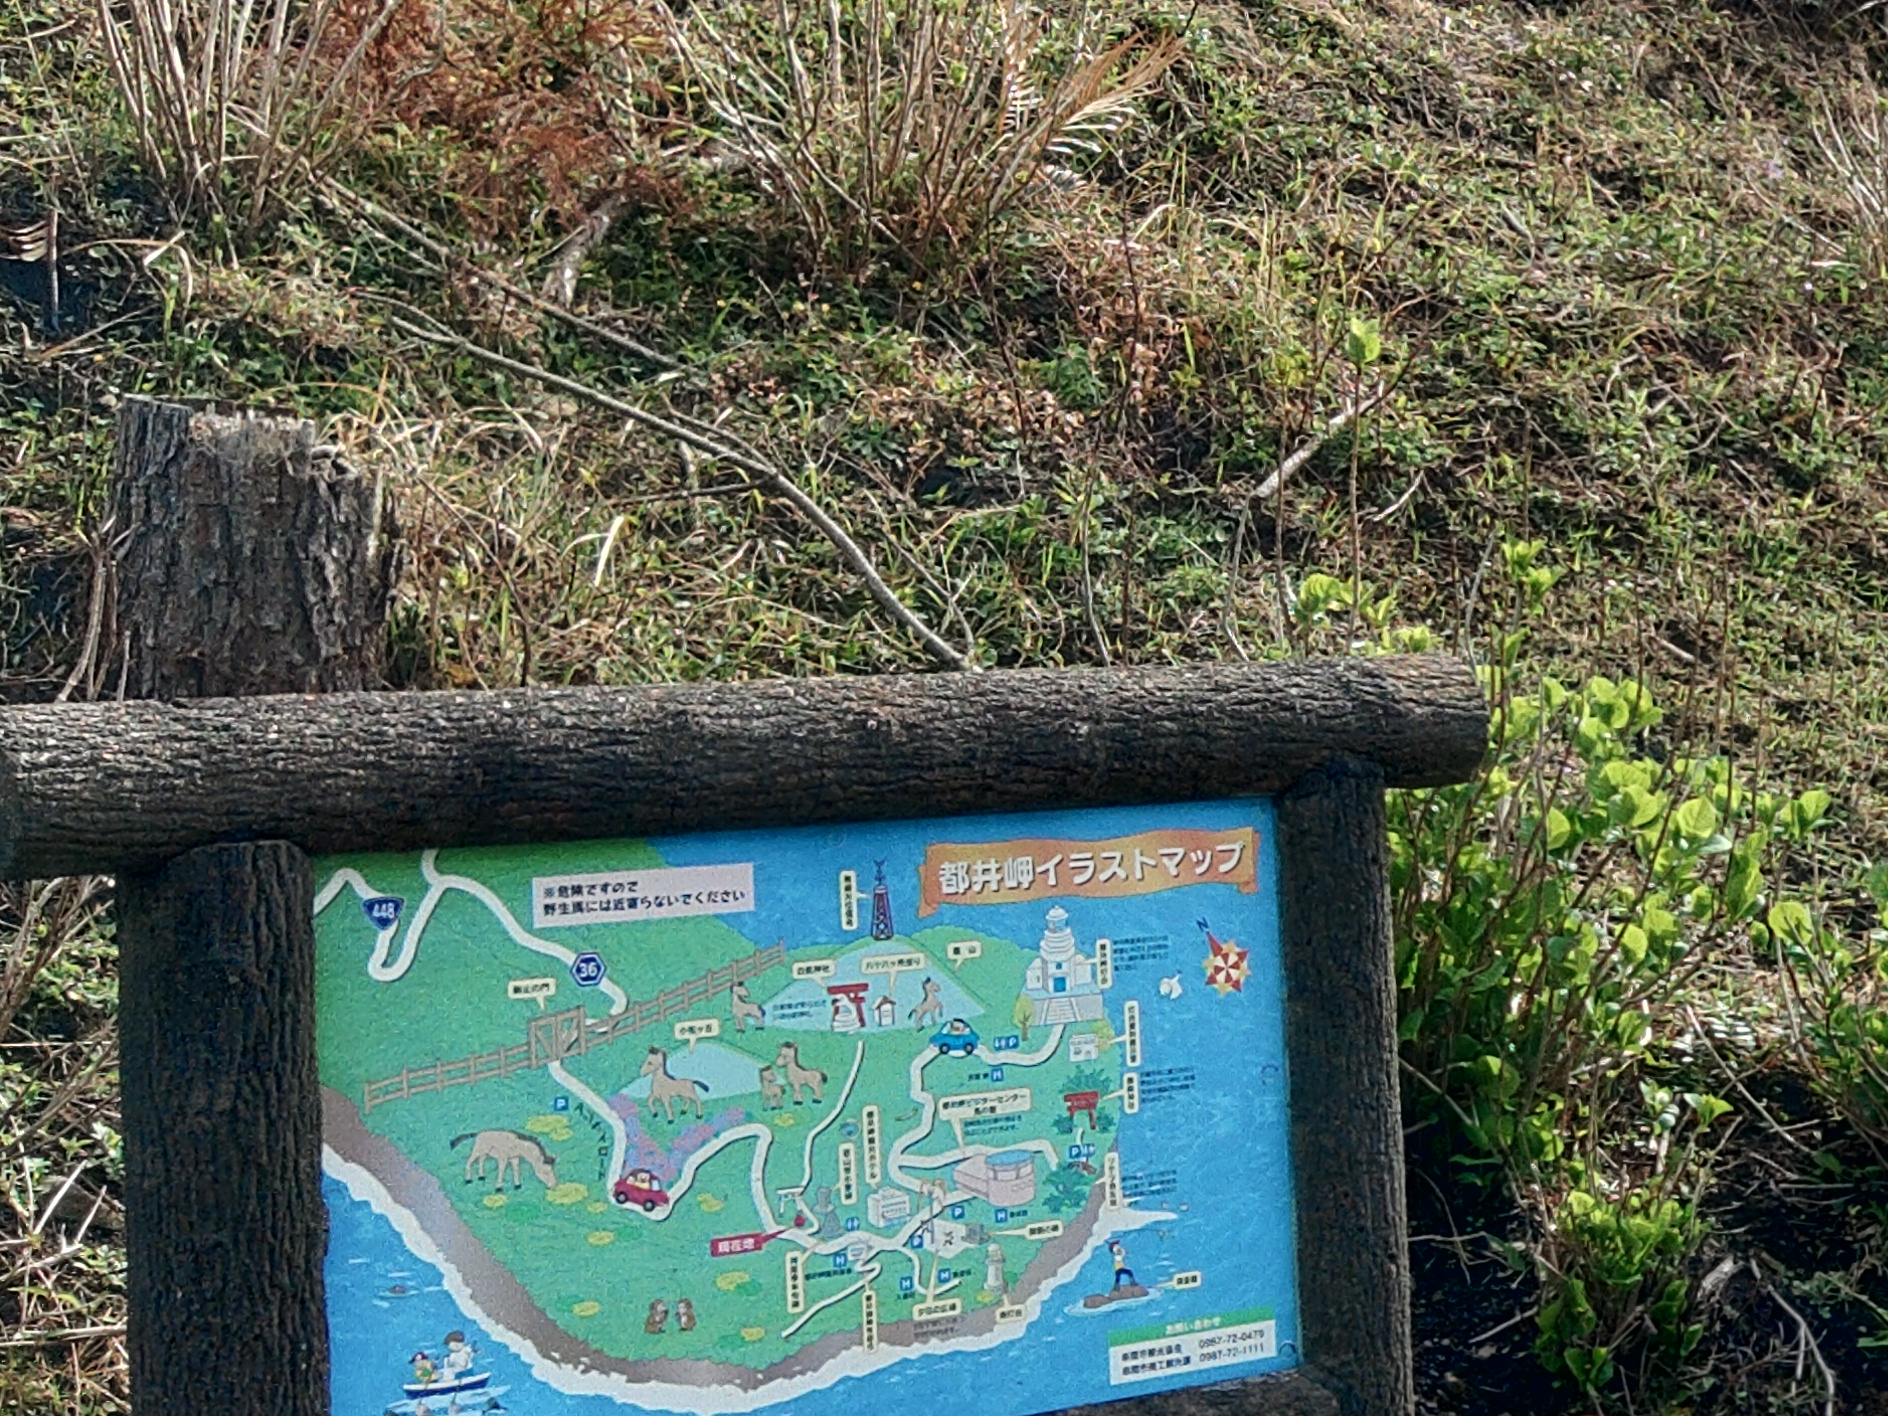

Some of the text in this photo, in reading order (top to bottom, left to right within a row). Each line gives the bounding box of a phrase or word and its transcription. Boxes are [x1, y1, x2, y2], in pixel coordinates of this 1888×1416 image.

[940, 840, 1246, 894] 都井岬イラストマップ
[543, 881, 639, 899] ※危険ですので
[372, 903, 396, 920] 448
[543, 890, 746, 916] 野生馬には近寄らないでください
[1196, 917, 1209, 931] N
[579, 962, 598, 978] 36
[1199, 1344, 1265, 1363] 0987-72-1111
